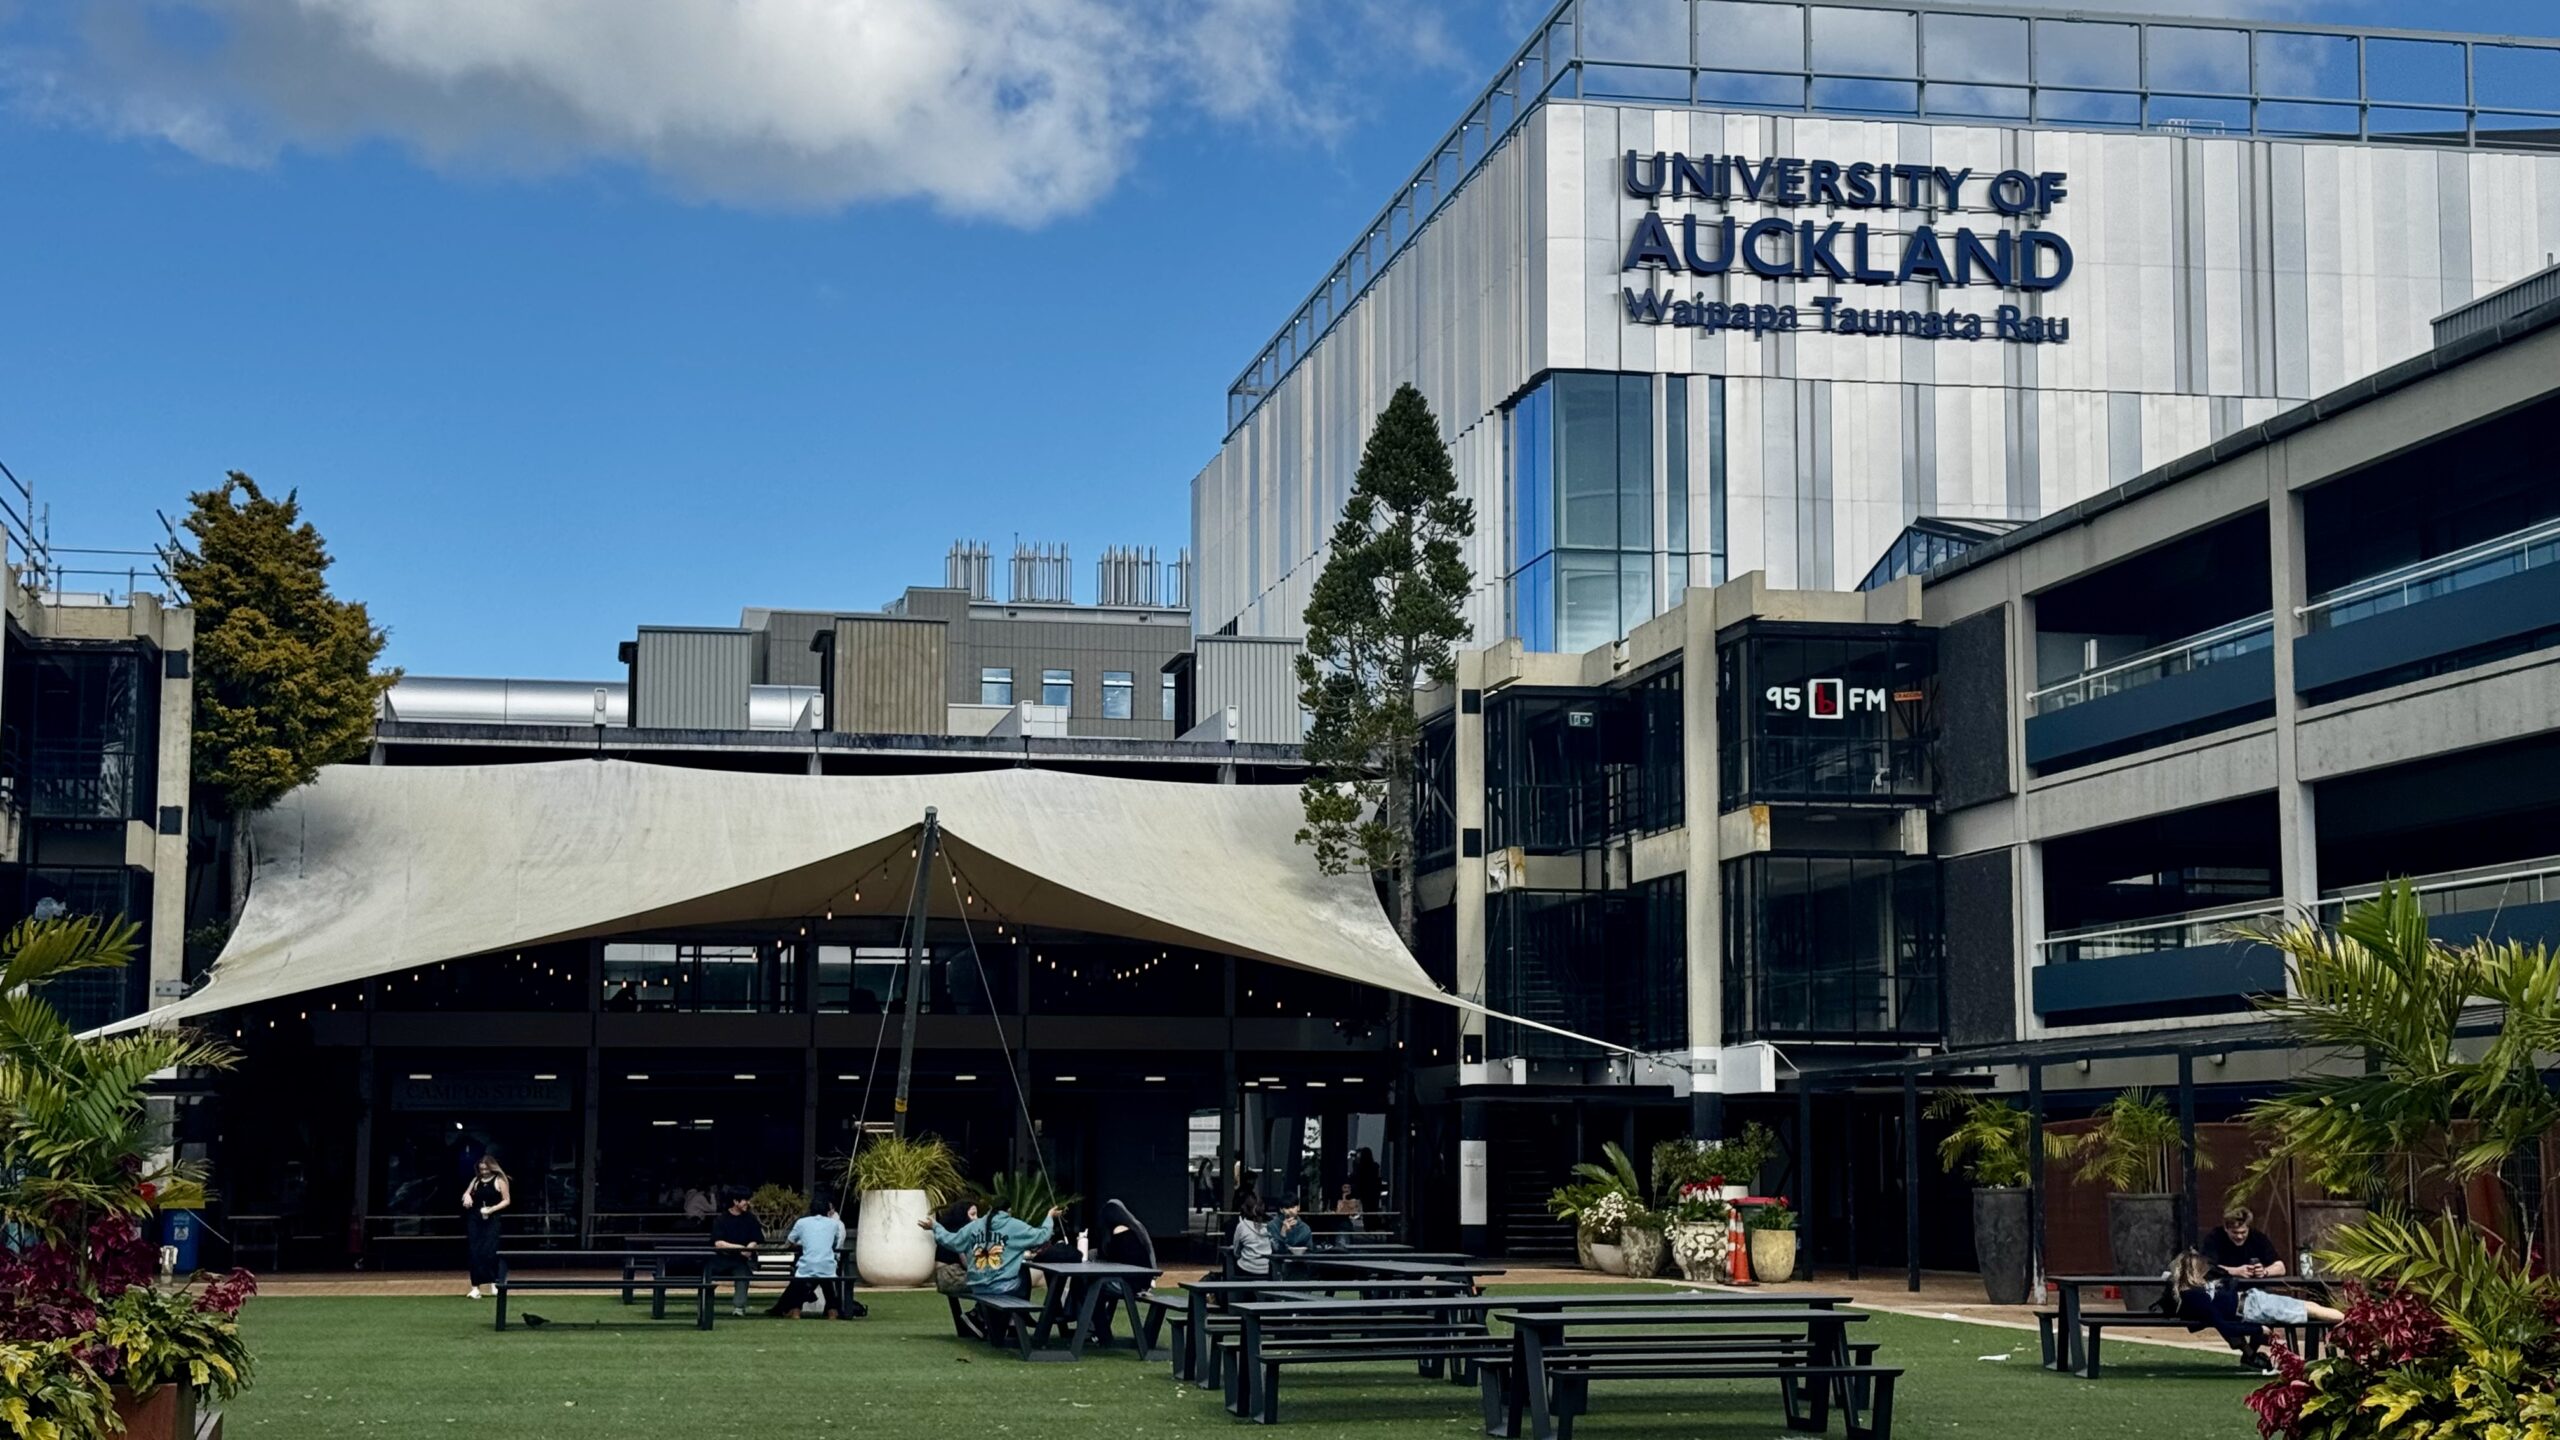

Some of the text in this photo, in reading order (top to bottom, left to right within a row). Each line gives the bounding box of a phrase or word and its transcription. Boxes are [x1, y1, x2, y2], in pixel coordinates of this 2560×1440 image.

[1626, 149, 2068, 214] UNIVERSITY OF
[1623, 211, 2074, 291] AUCKLAND
[1623, 286, 2070, 342] Waipapa Taumata Rau
[1765, 686, 1801, 711] 95
[1849, 687, 1887, 712] FM
